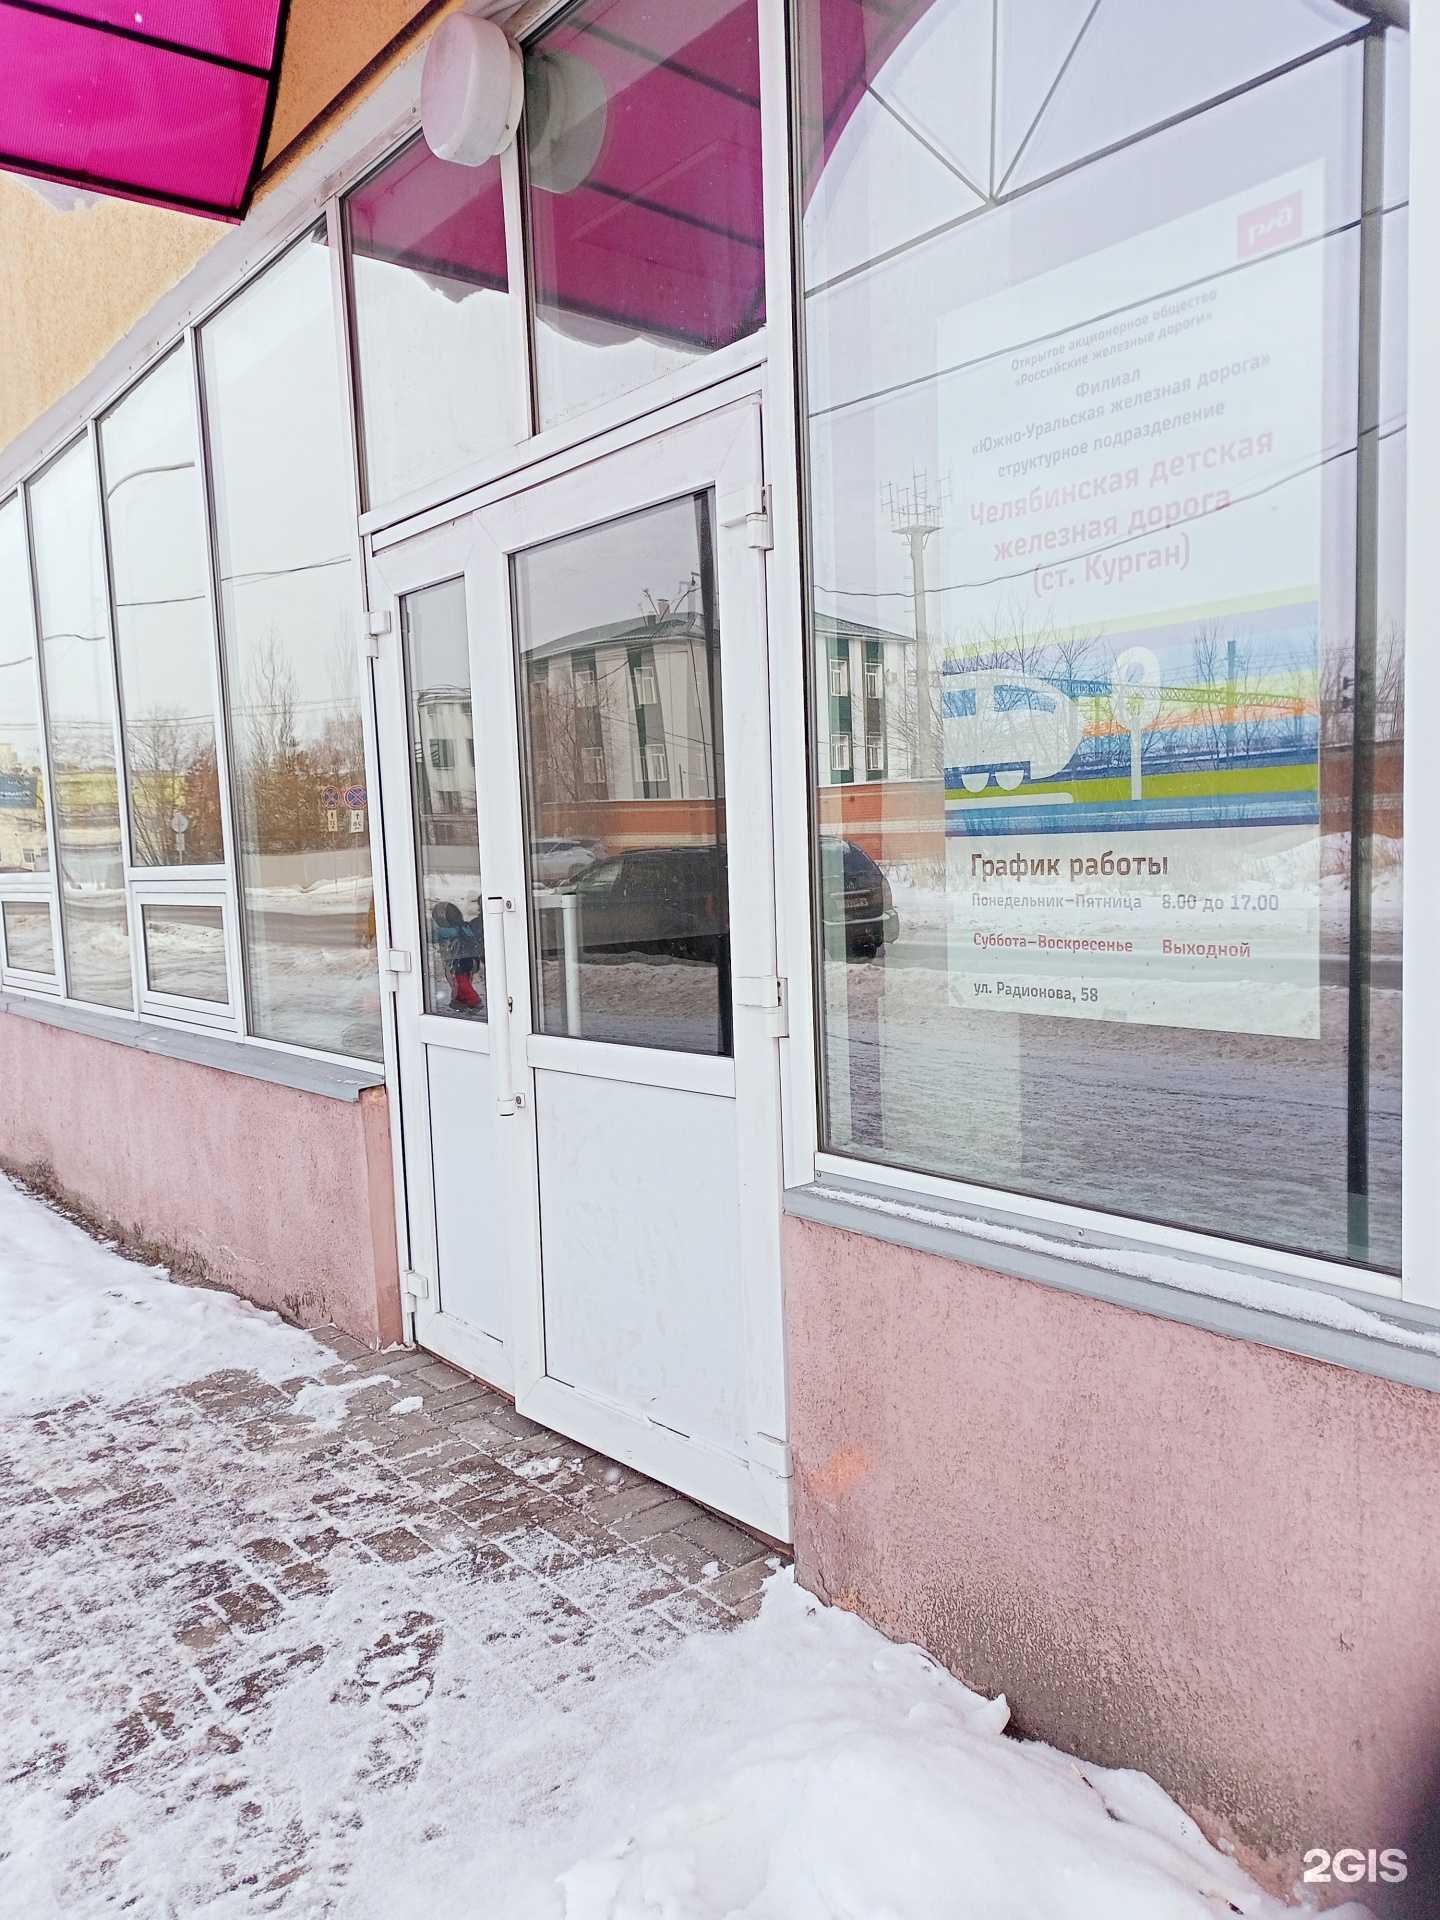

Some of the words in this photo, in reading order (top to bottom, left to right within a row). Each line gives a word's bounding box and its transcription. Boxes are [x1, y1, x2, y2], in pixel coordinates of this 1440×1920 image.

[1011, 344, 1065, 371] Открытое
[1068, 315, 1149, 351] акционерное
[1153, 289, 1217, 321] общество
[1015, 354, 1088, 387] «Российские
[1092, 333, 1153, 360] железные
[1157, 311, 1213, 339] дороги»
[972, 404, 1105, 456] «Южно-Уральская
[1110, 377, 1191, 415] железная
[1196, 353, 1271, 390] дорога»
[1075, 368, 1141, 398] Филиал
[997, 441, 1089, 478] структурное
[1092, 401, 1225, 451] подразделение
[970, 467, 1139, 525] Челябинская
[1149, 431, 1273, 488] детская
[993, 515, 1118, 562] железная
[1127, 488, 1231, 535] дорога
[1033, 563, 1076, 598] (ст.
[1085, 531, 1190, 586] Курган)
[971, 853, 1060, 882] График
[1070, 850, 1168, 882] работы
[1162, 894, 1197, 910] 8.00
[1203, 897, 1225, 912] до
[1231, 894, 1279, 911] 17.00
[1162, 939, 1250, 959] Выходной
[974, 982, 992, 995] ул.
[996, 981, 1076, 1003] Радионова,
[1081, 987, 1099, 1002] 58
